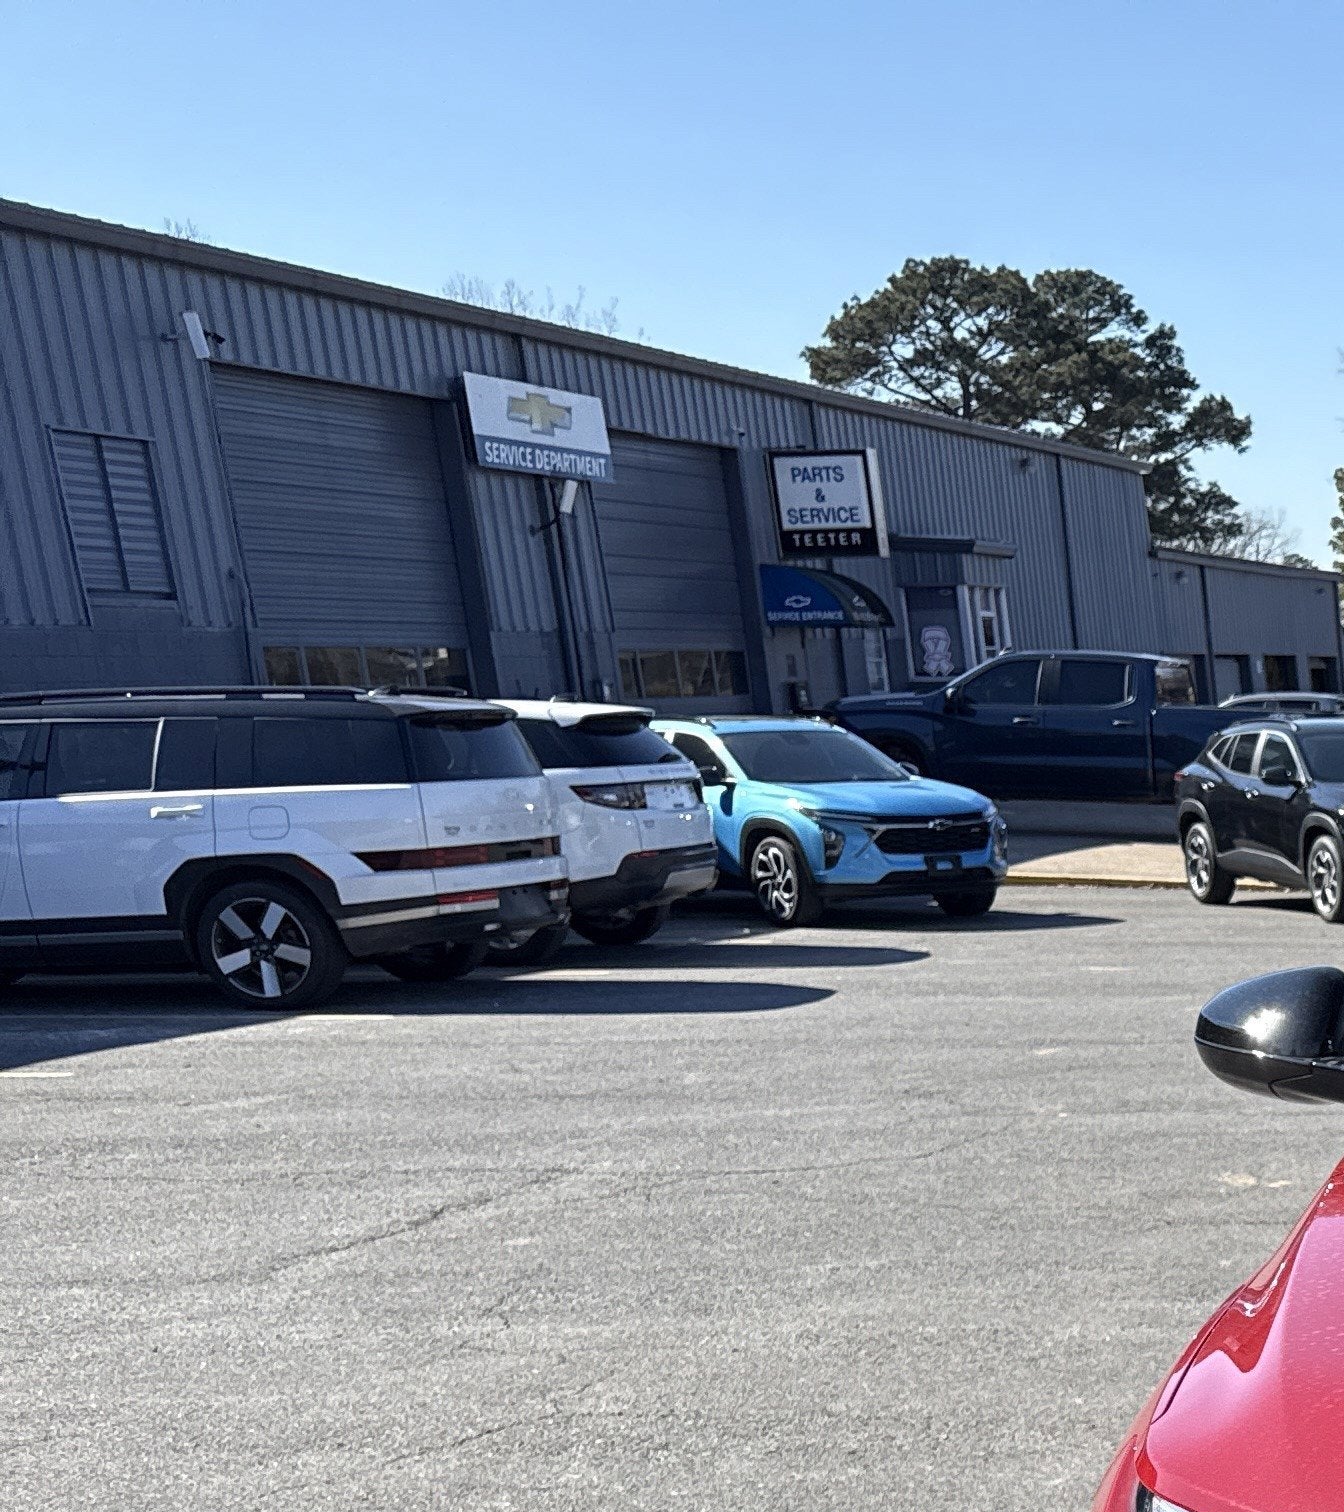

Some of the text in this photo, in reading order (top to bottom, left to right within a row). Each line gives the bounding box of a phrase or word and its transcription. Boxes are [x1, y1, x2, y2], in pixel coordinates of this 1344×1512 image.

[484, 441, 607, 478] SERVICE DEPARTMENT
[790, 465, 845, 483] PARTS
[814, 487, 826, 503] &
[786, 506, 861, 525] SERVICE
[792, 532, 862, 547] TEETER
